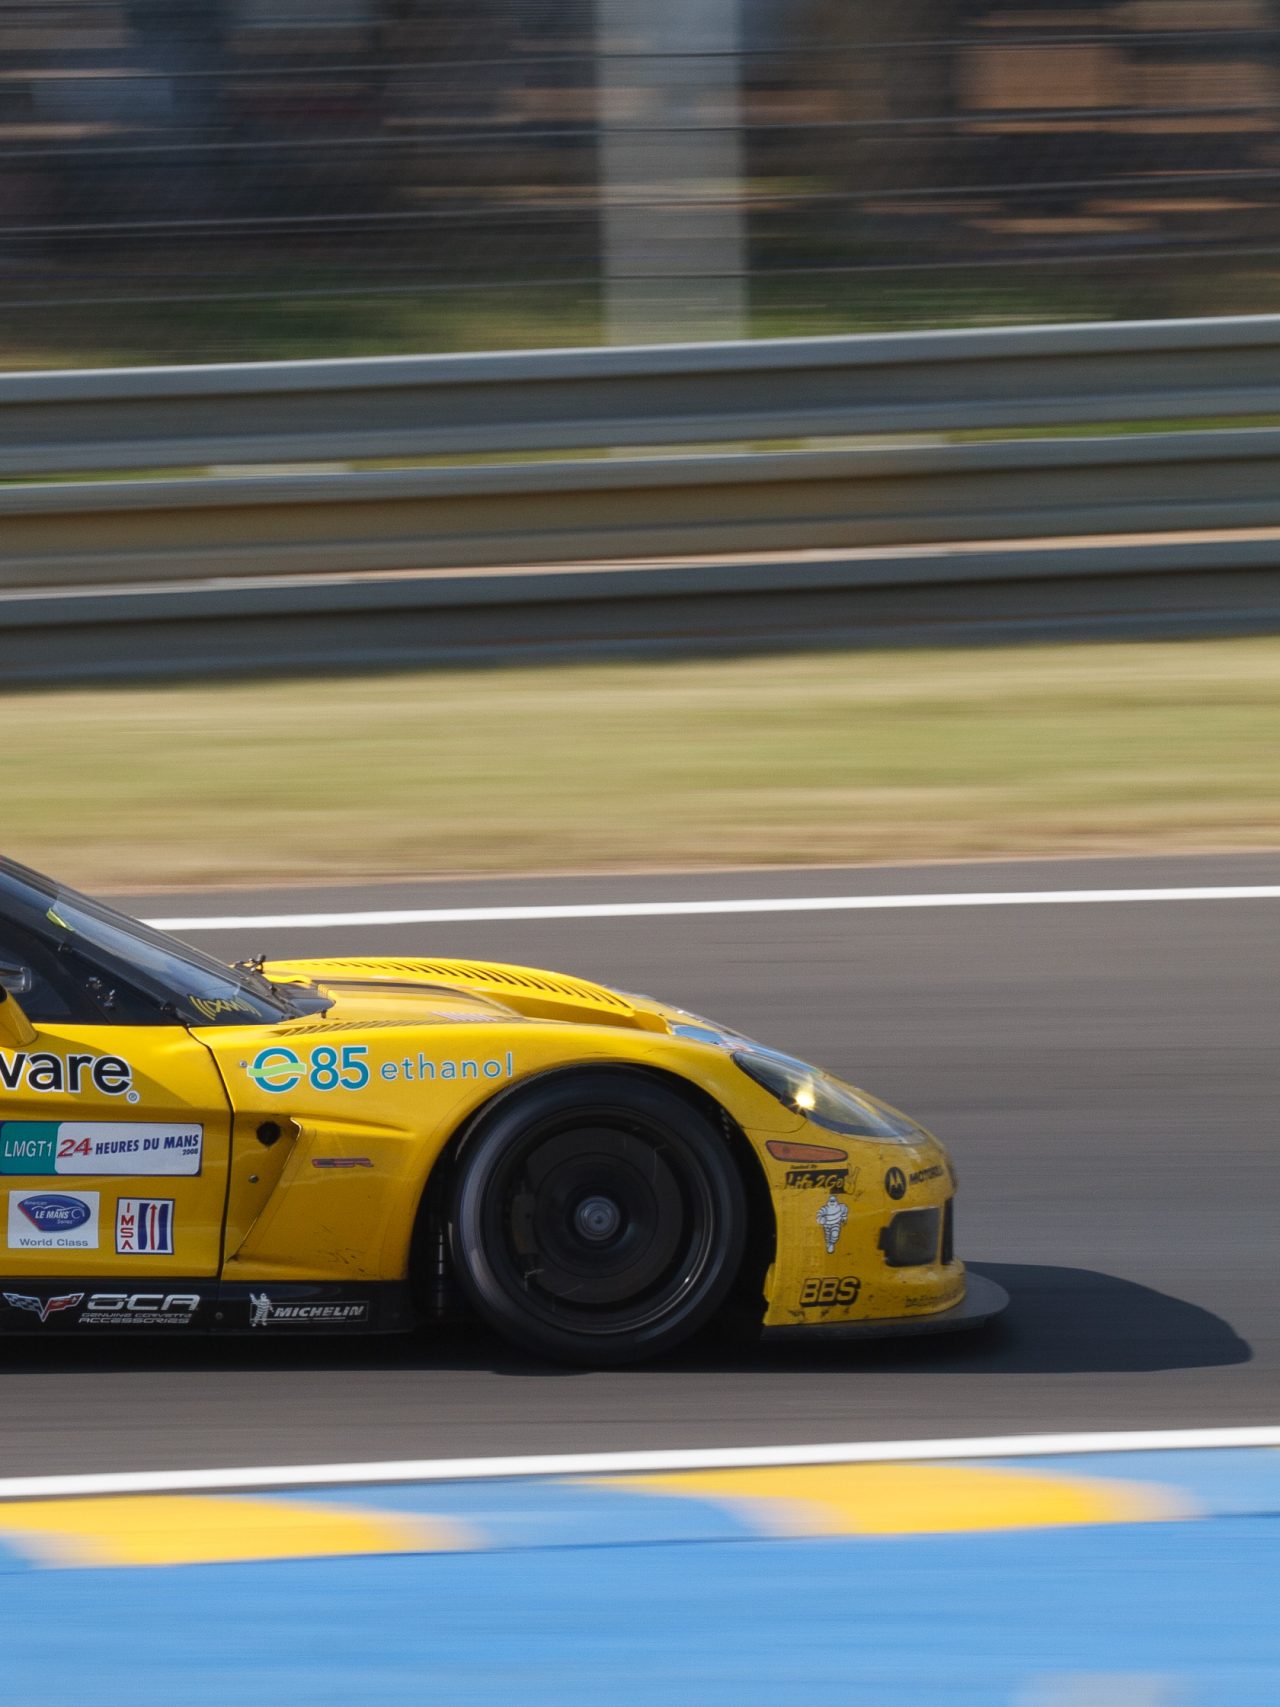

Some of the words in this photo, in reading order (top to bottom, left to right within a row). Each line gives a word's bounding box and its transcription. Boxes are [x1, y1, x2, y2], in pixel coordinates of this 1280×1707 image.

[380, 1051, 514, 1081] ethanol
[3, 1140, 52, 1157] LMGT1
[56, 1137, 93, 1159] 24
[95, 1139, 139, 1155] HEURES
[143, 1138, 160, 1150] DU
[163, 1134, 199, 1149] MANS
[34, 1209, 46, 1219] LE
[46, 1209, 70, 1219] MANS
[19, 1237, 53, 1247] World
[56, 1238, 89, 1247] Class
[799, 1276, 862, 1308] BBS
[273, 1305, 365, 1318] MICHELIN
[78, 1317, 191, 1325] ACCESSORIES
